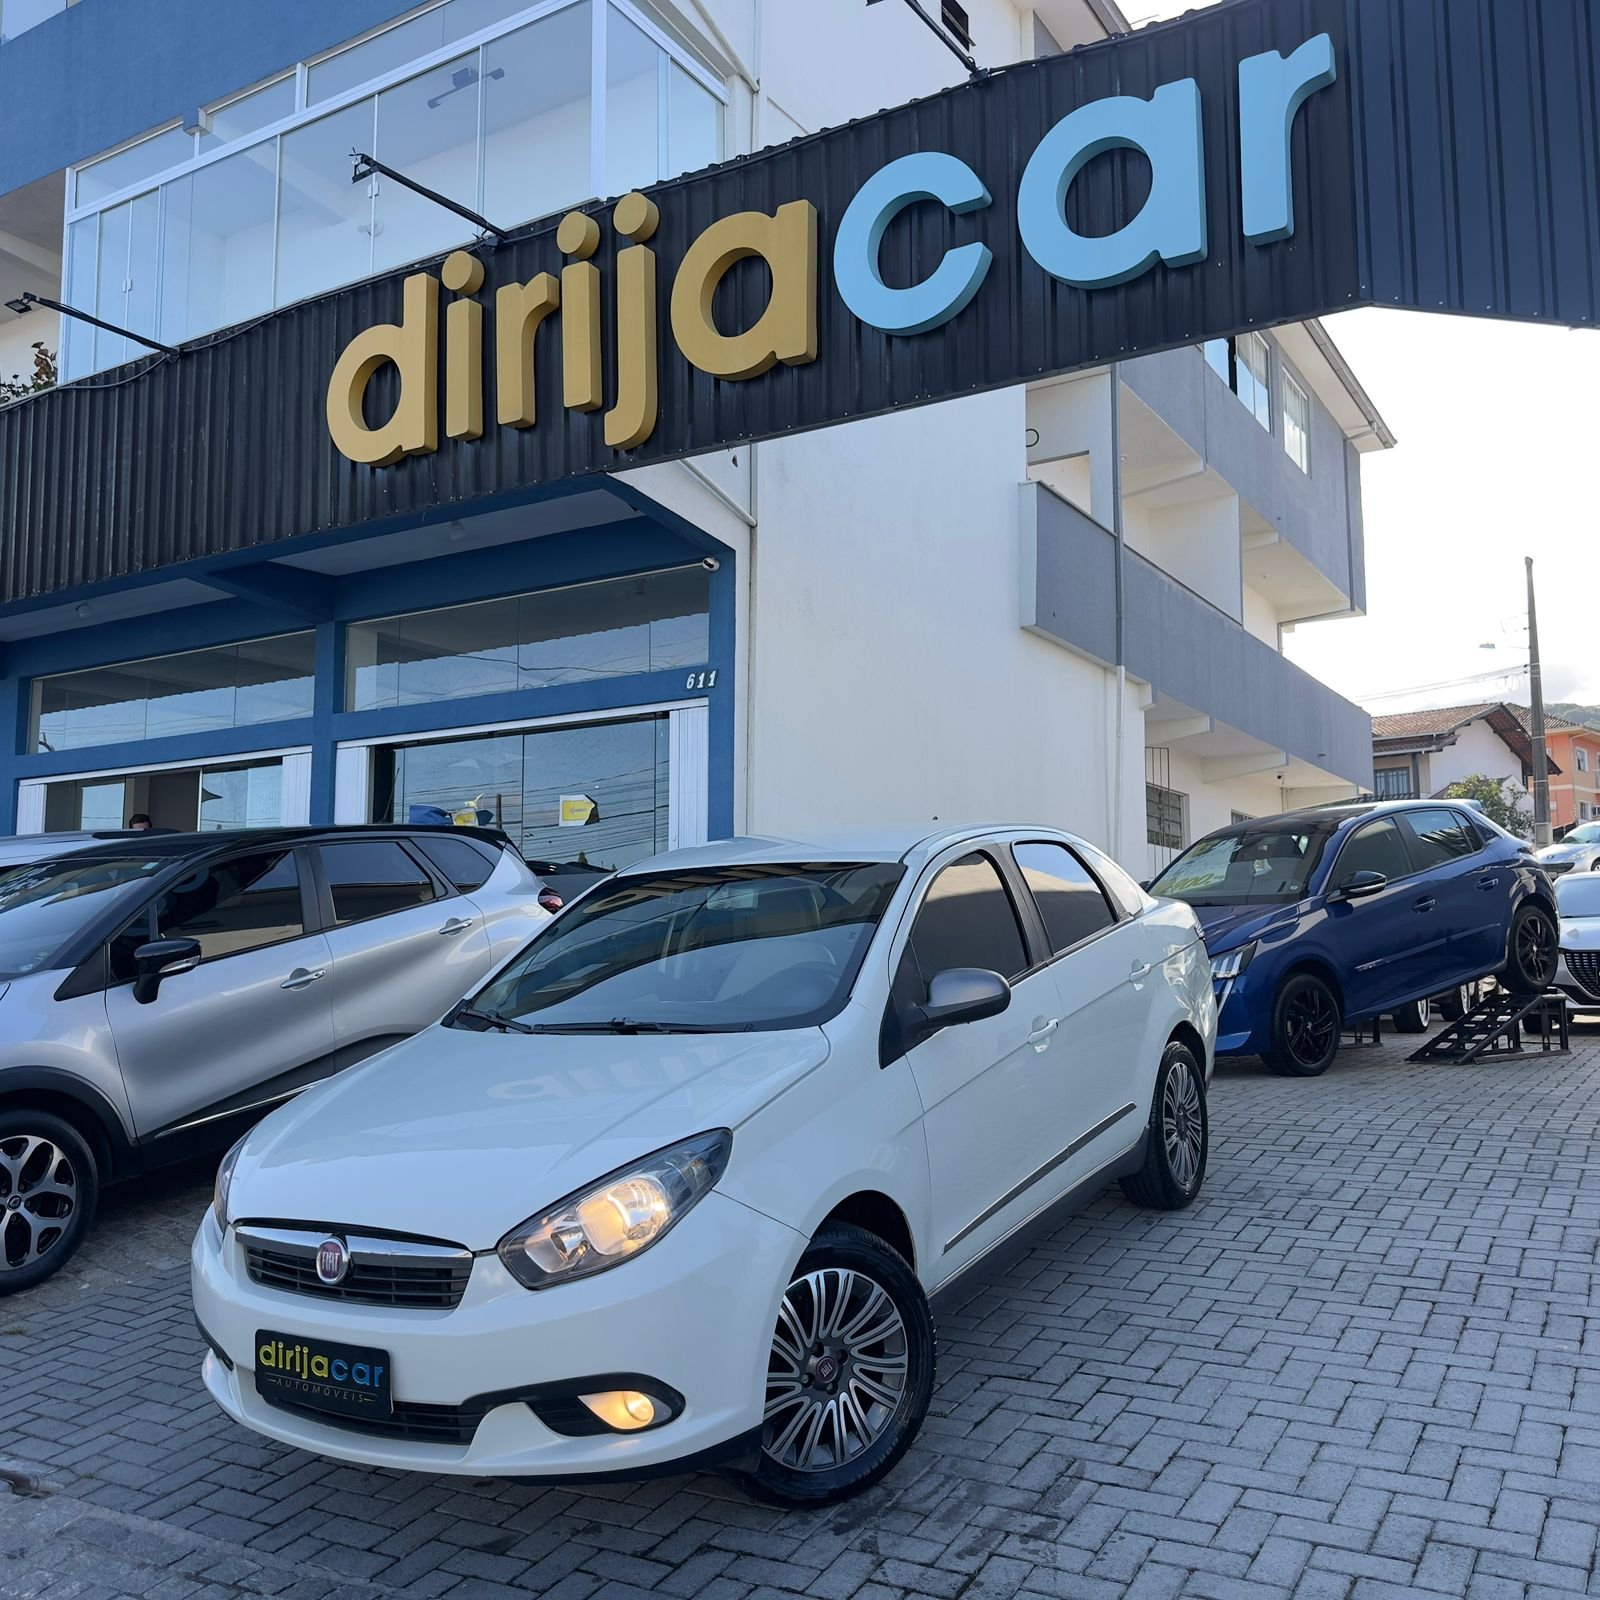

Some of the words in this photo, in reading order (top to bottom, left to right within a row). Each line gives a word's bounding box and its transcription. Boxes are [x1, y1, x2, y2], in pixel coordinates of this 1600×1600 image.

[327, 33, 1337, 467] dirijacar
[686, 670, 716, 689] 611
[321, 1251, 341, 1271] FIAT
[259, 1340, 384, 1387] dirijacar
